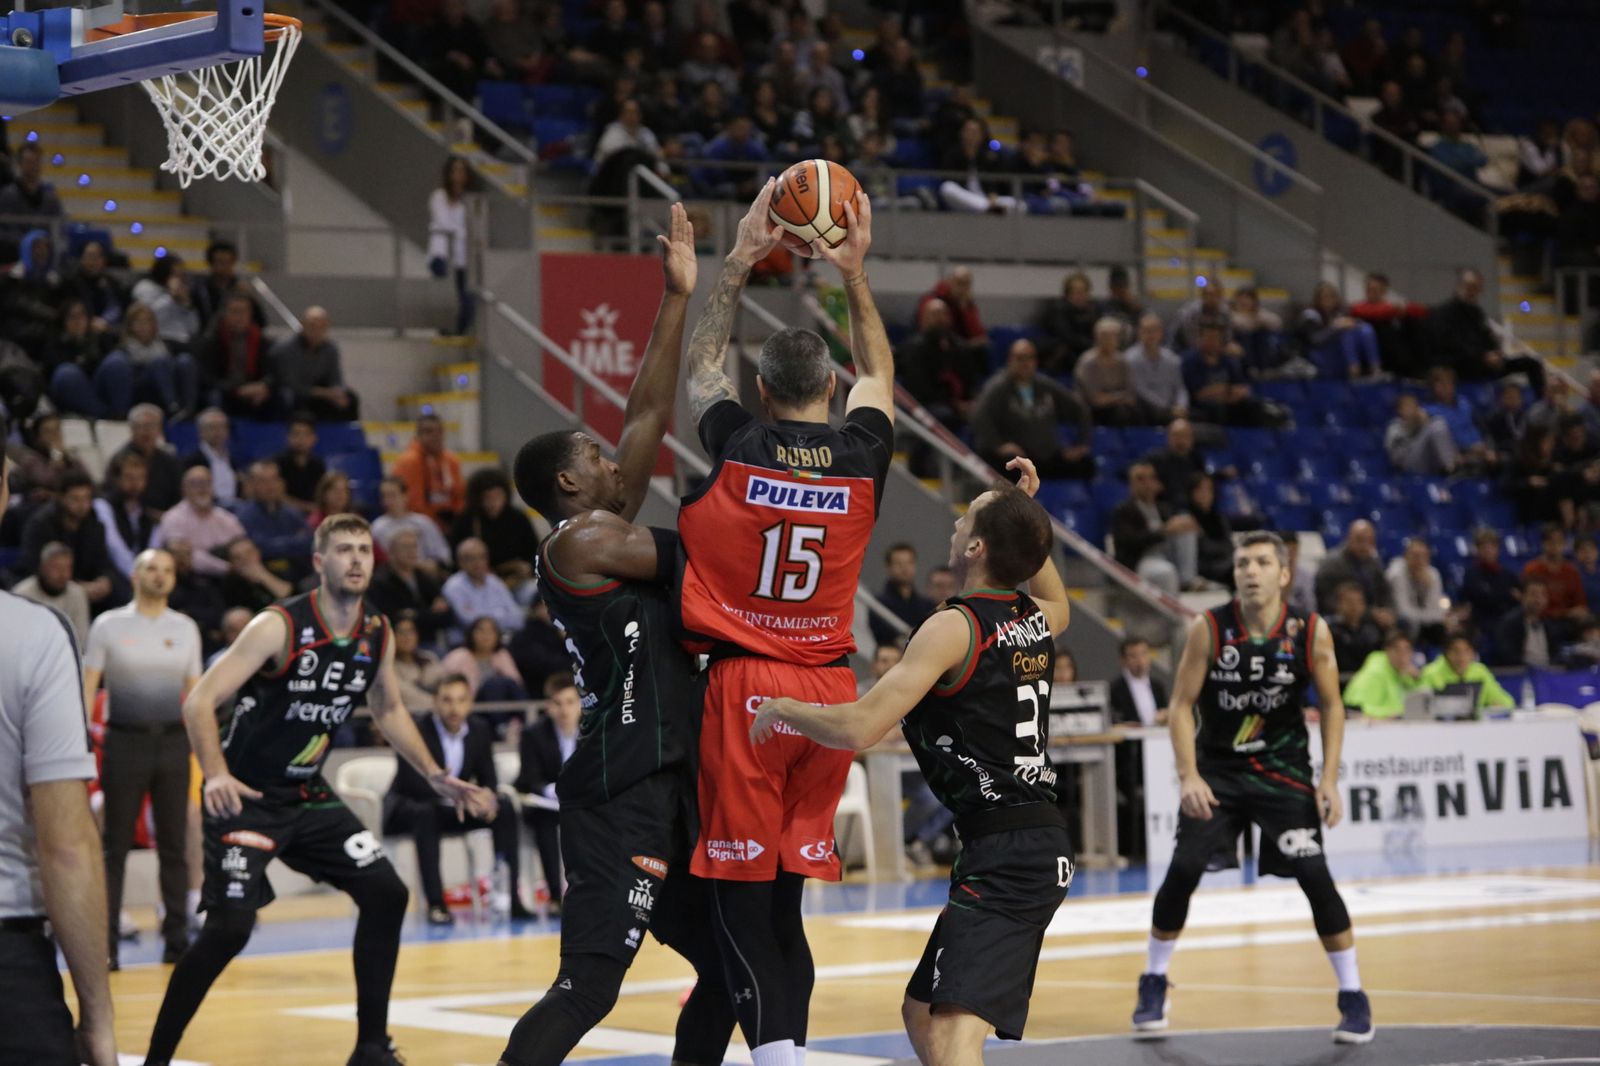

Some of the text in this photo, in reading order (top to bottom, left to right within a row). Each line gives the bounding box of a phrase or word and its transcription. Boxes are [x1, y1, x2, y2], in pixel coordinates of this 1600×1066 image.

[776, 444, 833, 468] RUBIO
[748, 478, 846, 511] PULEVA
[747, 518, 827, 603] 15
[1249, 655, 1266, 681] 5
[1354, 753, 1465, 778] restaurant
[1350, 781, 1468, 823] RAN
[708, 848, 746, 862] Digital
[627, 888, 655, 911] IME
